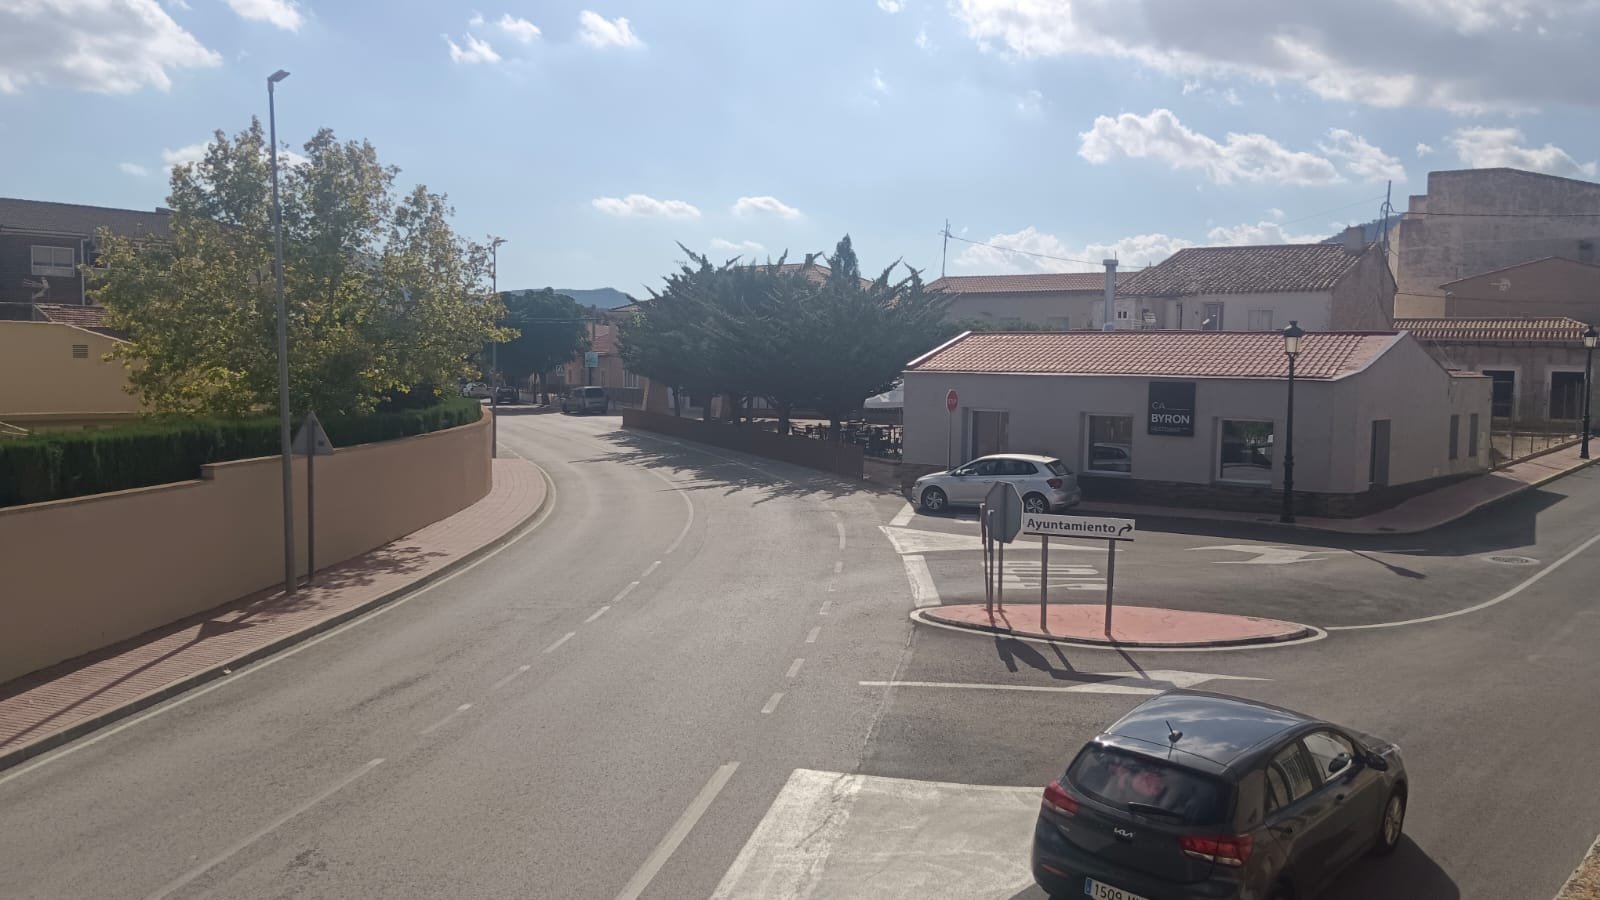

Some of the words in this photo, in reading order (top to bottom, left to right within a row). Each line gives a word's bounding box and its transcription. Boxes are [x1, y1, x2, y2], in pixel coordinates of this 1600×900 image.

[1151, 401, 1166, 410] CA
[1151, 413, 1190, 424] BYRON
[1027, 518, 1116, 533] Ayuntamiento
